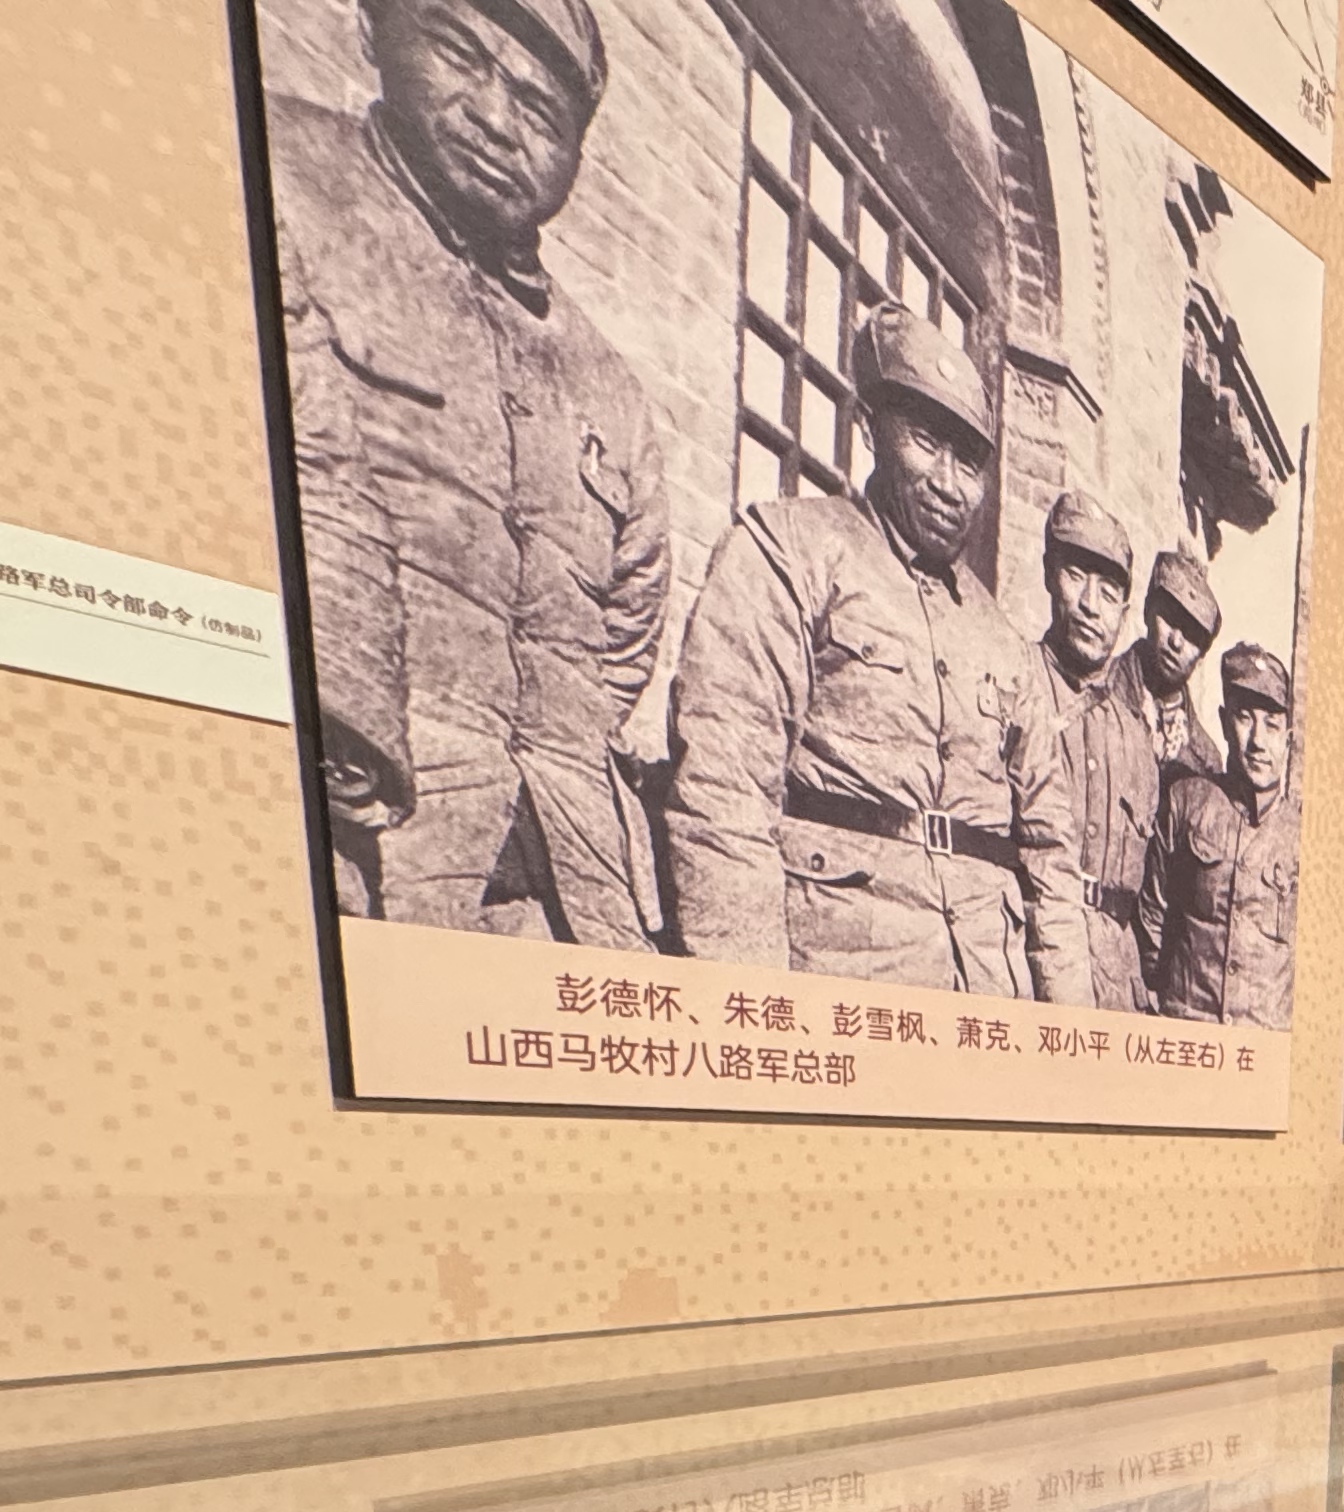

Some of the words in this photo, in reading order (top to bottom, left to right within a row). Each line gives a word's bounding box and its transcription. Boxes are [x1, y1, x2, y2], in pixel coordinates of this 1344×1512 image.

[465, 1027, 858, 1088] 山西马牧村八路军总部
[555, 972, 1255, 1073] 彭德怀、朱德、彭雪枫、萧克、邓小平（从左至右）在
